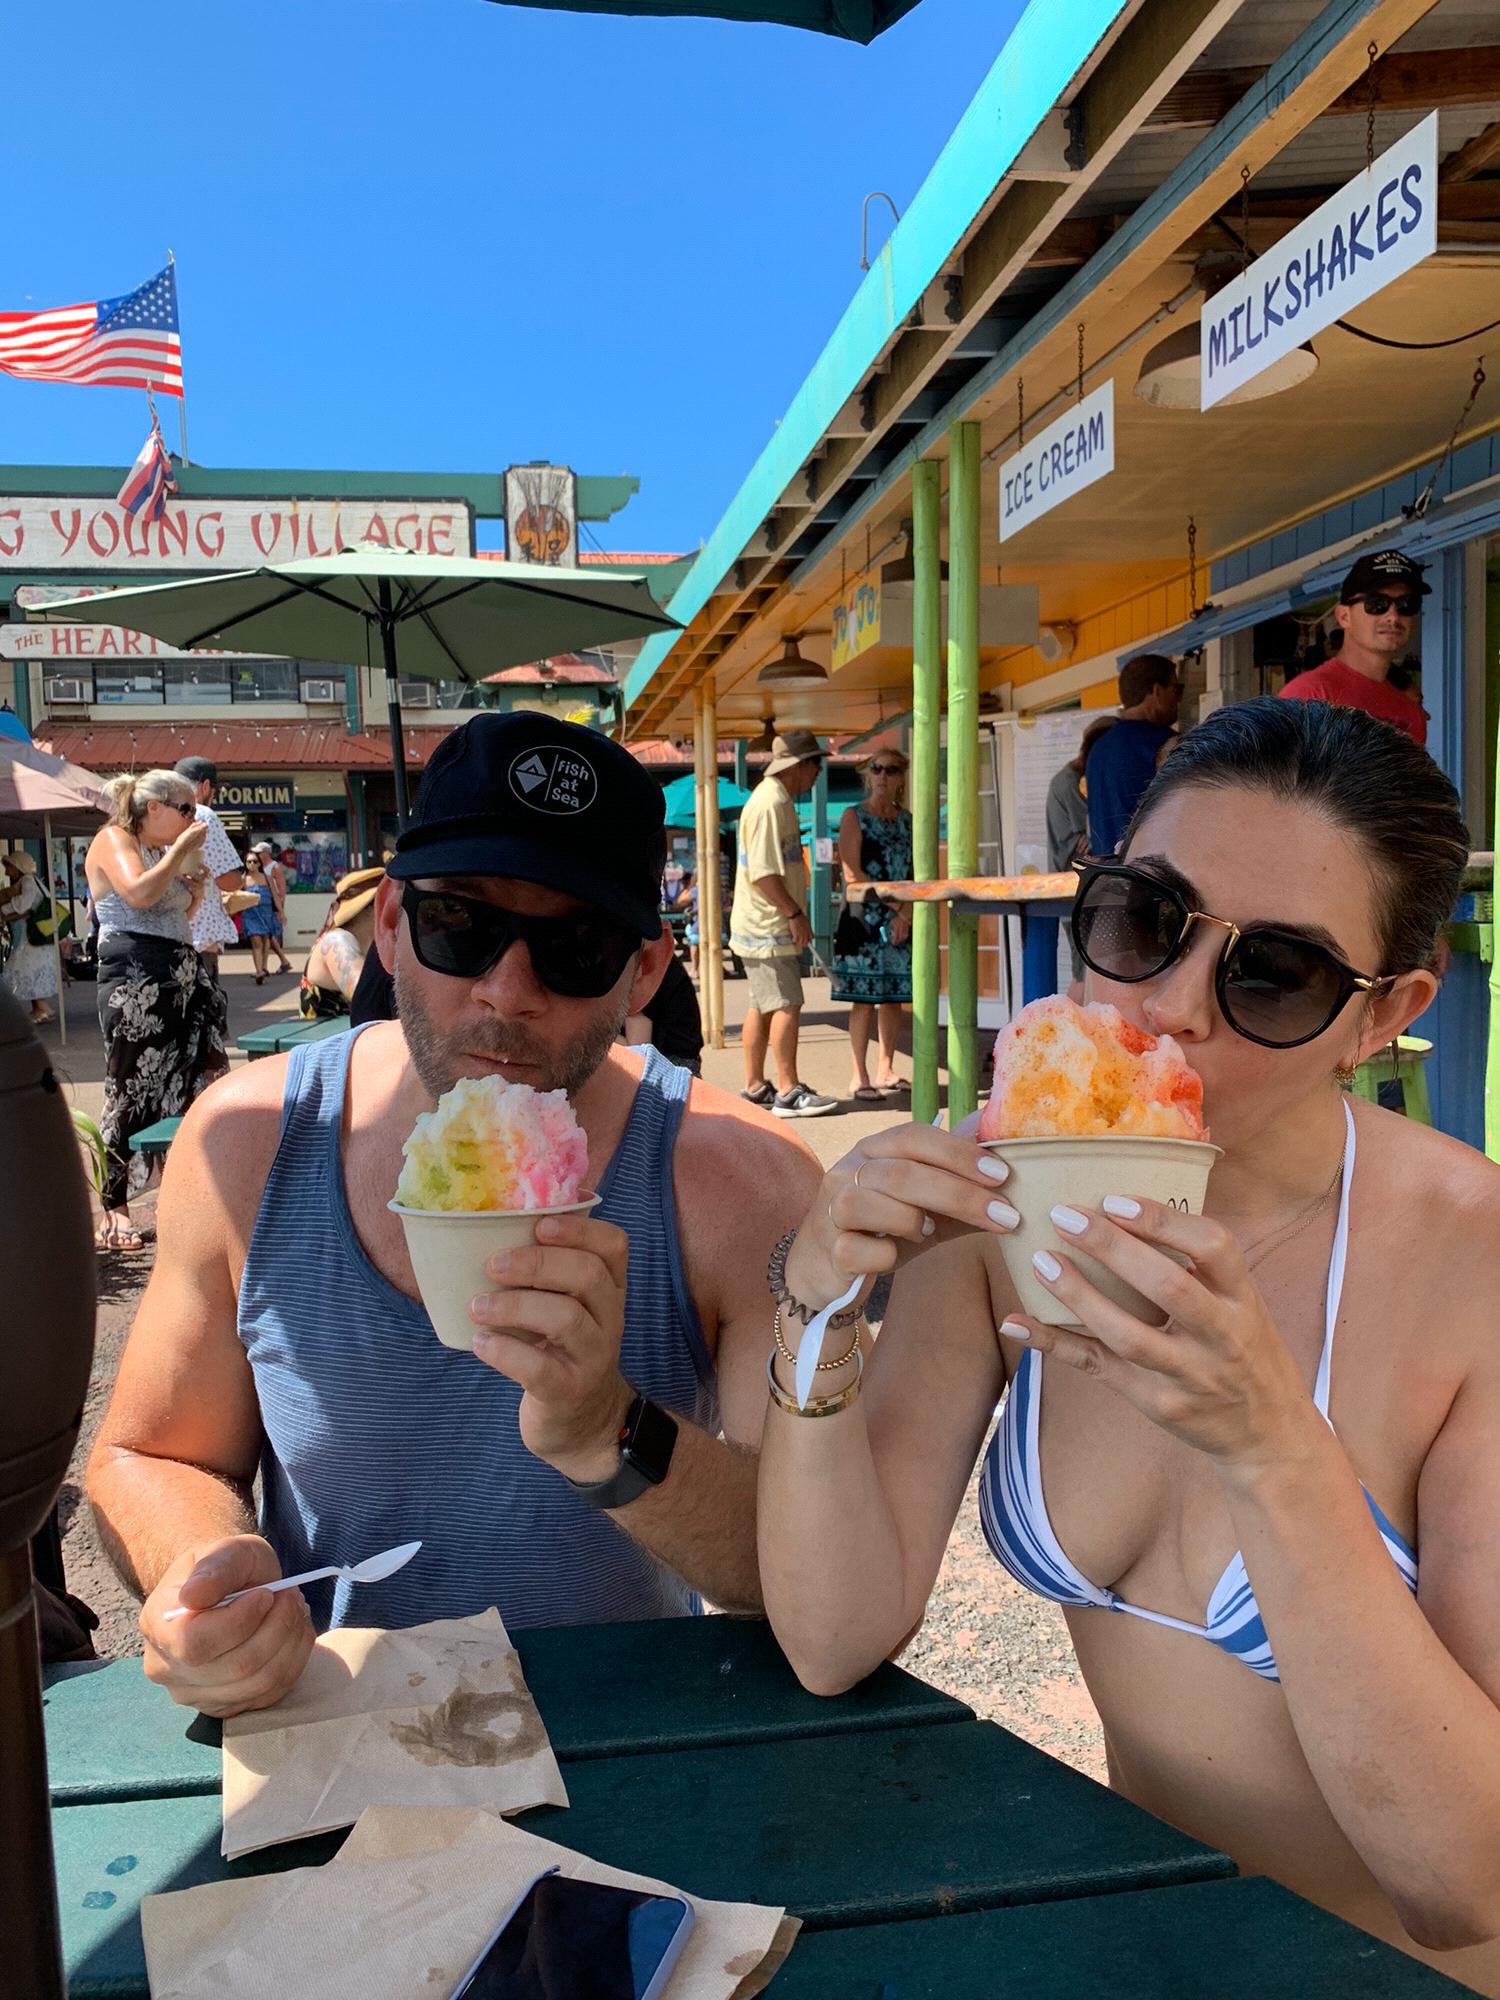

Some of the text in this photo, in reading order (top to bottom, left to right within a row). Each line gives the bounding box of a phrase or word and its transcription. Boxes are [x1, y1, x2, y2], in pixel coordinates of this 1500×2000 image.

[1209, 164, 1422, 378] MILKSHAKES
[1005, 411, 1104, 518] ICE CREAM
[50, 508, 225, 558] YOUNG
[250, 512, 456, 558] VILLAGE
[15, 633, 44, 651] THE
[212, 786, 290, 804] PORIUM
[560, 779, 579, 792] at
